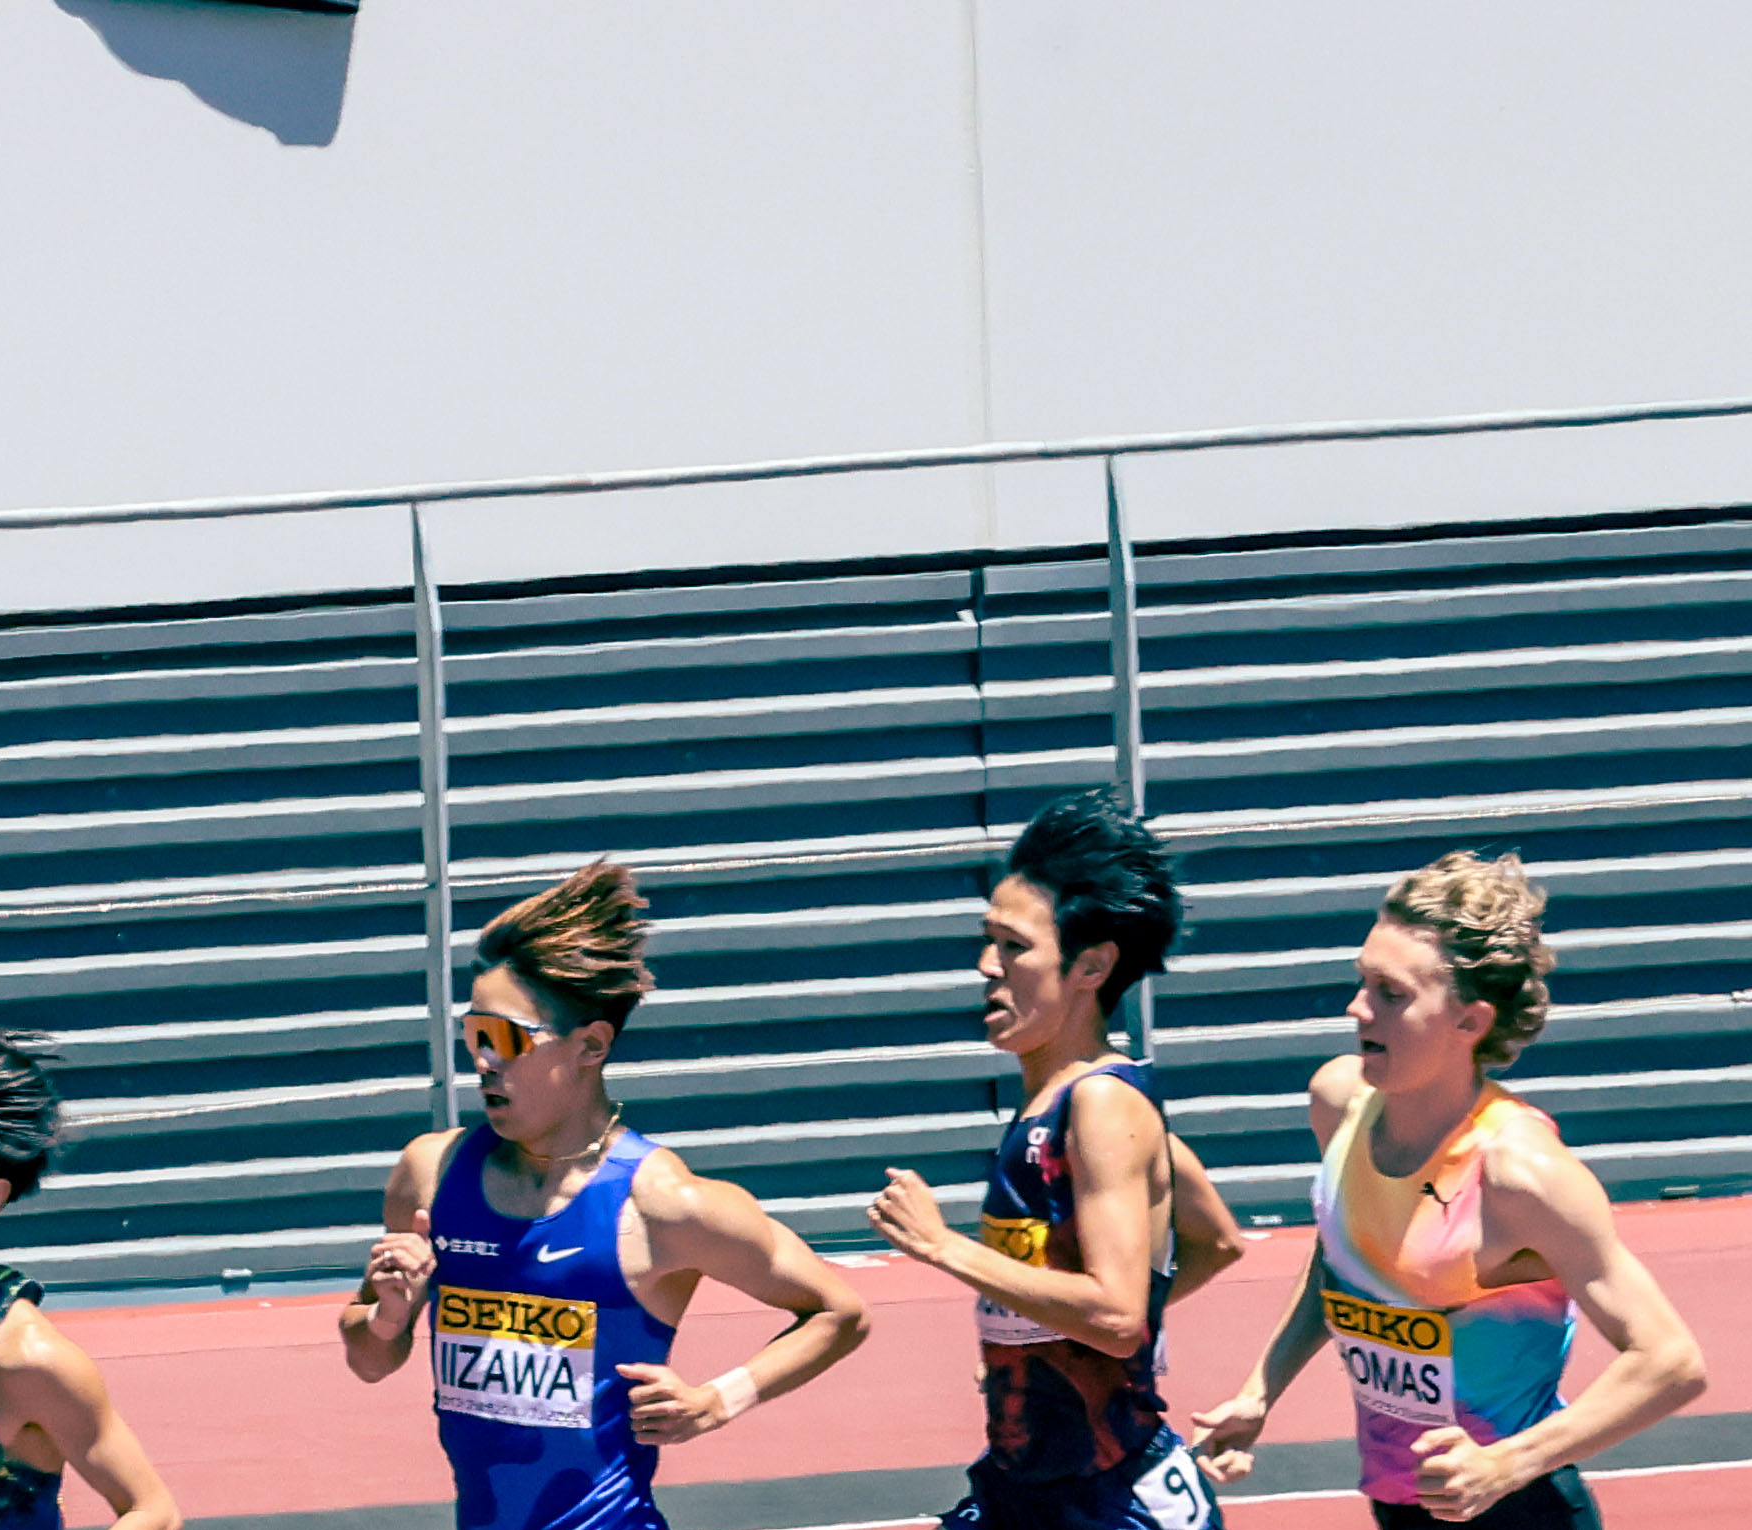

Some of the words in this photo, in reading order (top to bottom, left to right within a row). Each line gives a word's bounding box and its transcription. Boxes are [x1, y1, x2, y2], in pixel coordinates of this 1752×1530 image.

[442, 1294, 583, 1341] SEIKO
[1328, 1300, 1440, 1350] EIKO
[441, 1341, 577, 1401] IIZAWA
[1340, 1342, 1440, 1404] OMAS
[1166, 1466, 1198, 1524] 9
